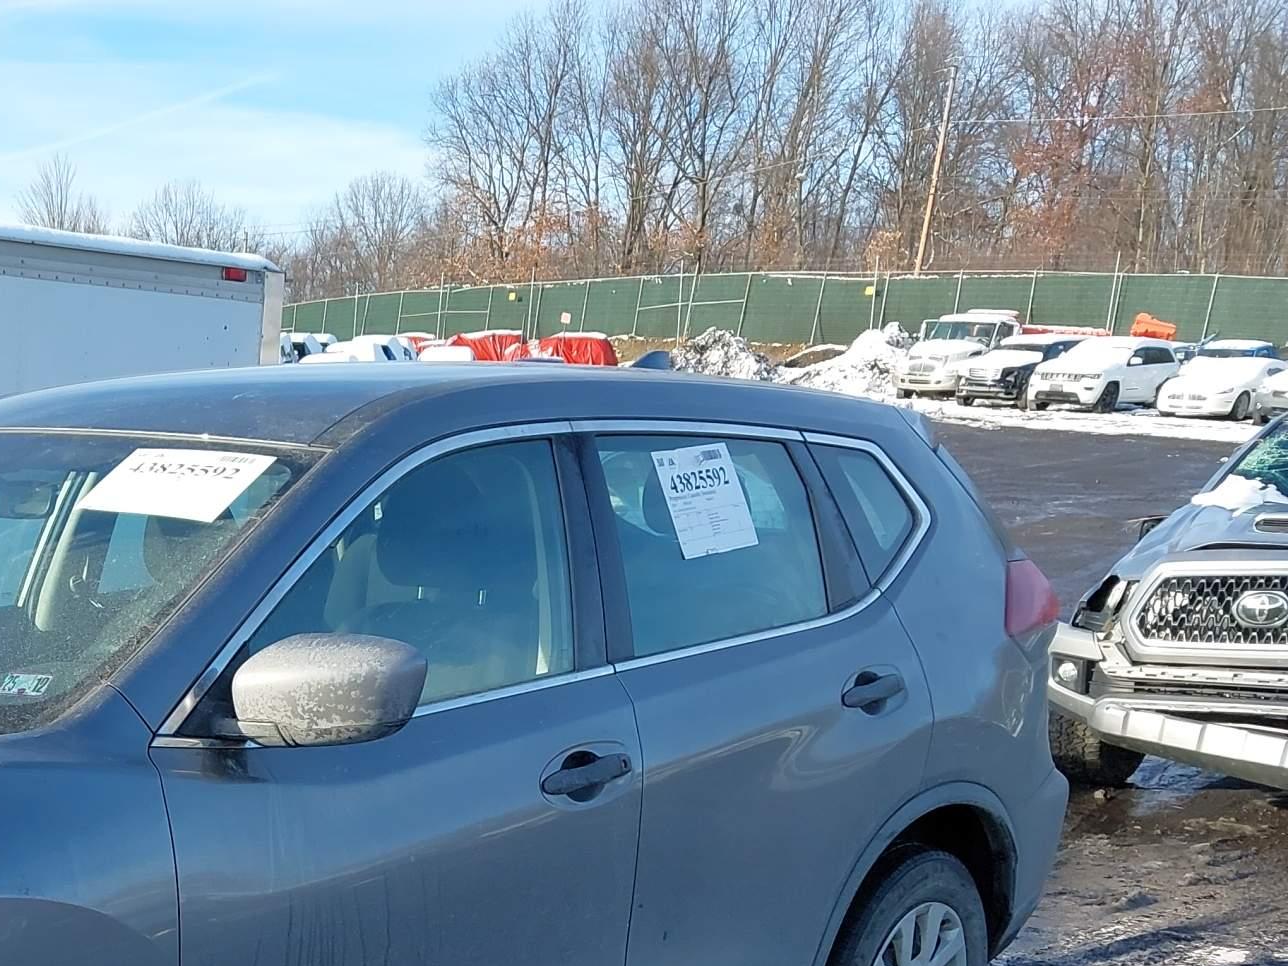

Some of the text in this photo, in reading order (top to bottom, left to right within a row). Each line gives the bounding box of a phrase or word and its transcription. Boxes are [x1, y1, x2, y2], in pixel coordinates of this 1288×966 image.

[129, 461, 242, 480] 43825592
[669, 466, 730, 494] 43825592
[31, 676, 50, 693] 12
